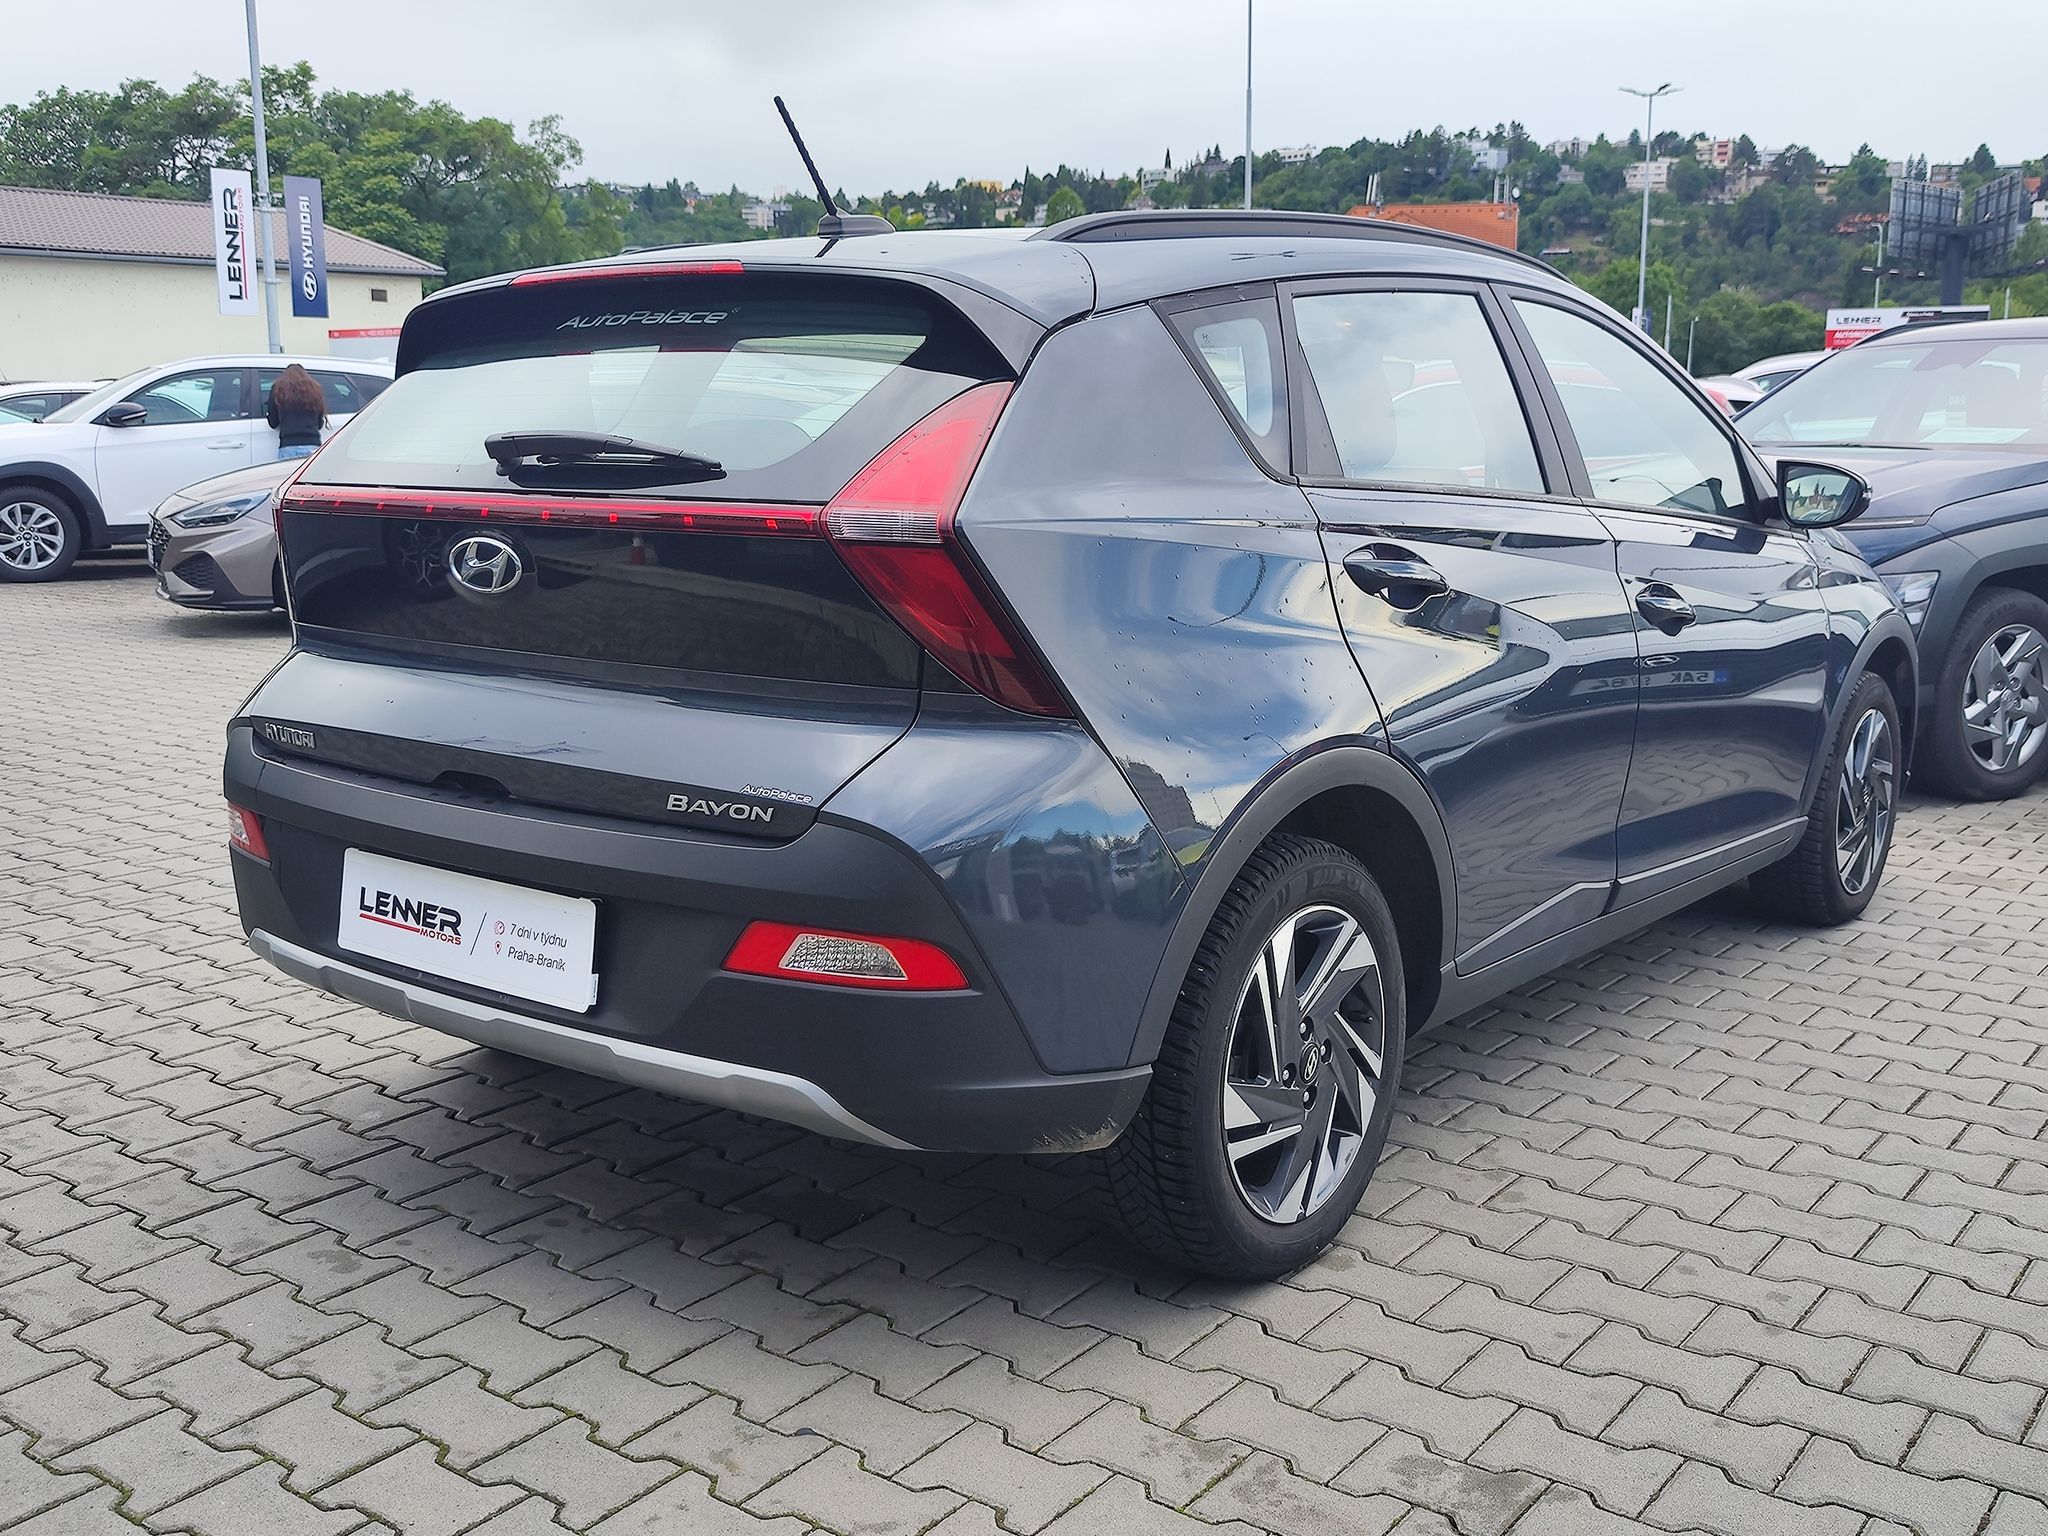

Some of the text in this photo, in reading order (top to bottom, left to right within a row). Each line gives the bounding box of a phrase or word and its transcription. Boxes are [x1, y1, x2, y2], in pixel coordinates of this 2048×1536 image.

[223, 187, 243, 300] LENNER
[299, 195, 314, 269] HYUNDAI
[556, 310, 728, 330] AutoPalace
[265, 722, 315, 748] HYUNDAI
[739, 784, 812, 803] AutoPalace
[666, 794, 775, 823] BAYON
[359, 886, 461, 936] LENNER
[420, 928, 461, 945] MOTORS
[510, 923, 567, 947] 7 dní v týdnu
